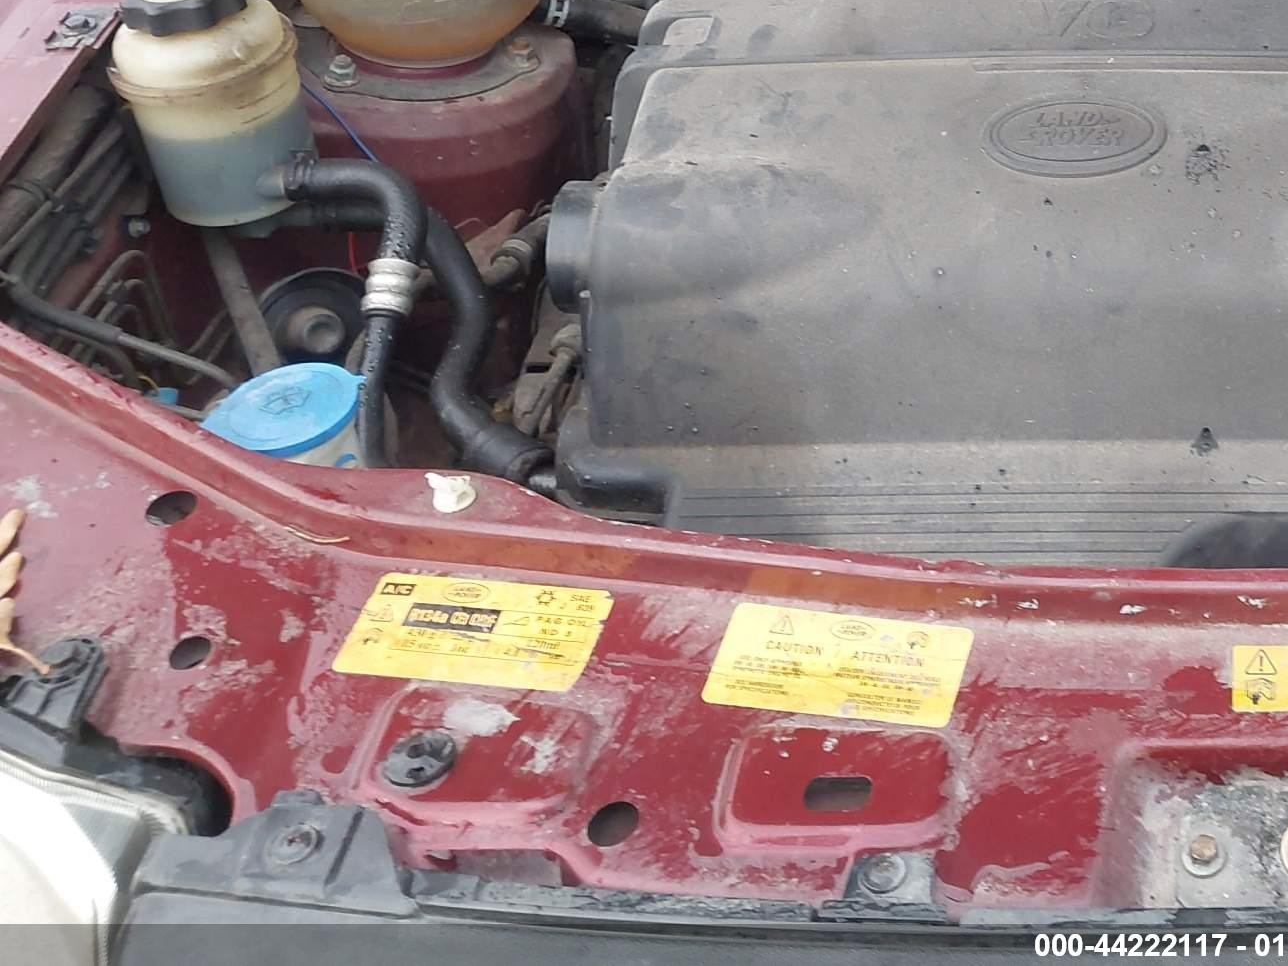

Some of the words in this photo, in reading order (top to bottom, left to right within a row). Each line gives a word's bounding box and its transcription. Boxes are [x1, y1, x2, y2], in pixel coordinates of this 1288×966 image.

[1034, 127, 1126, 147] ROVER
[383, 585, 412, 594] A/C
[766, 640, 824, 656] CAUTION
[850, 650, 925, 667] ATTENTION
